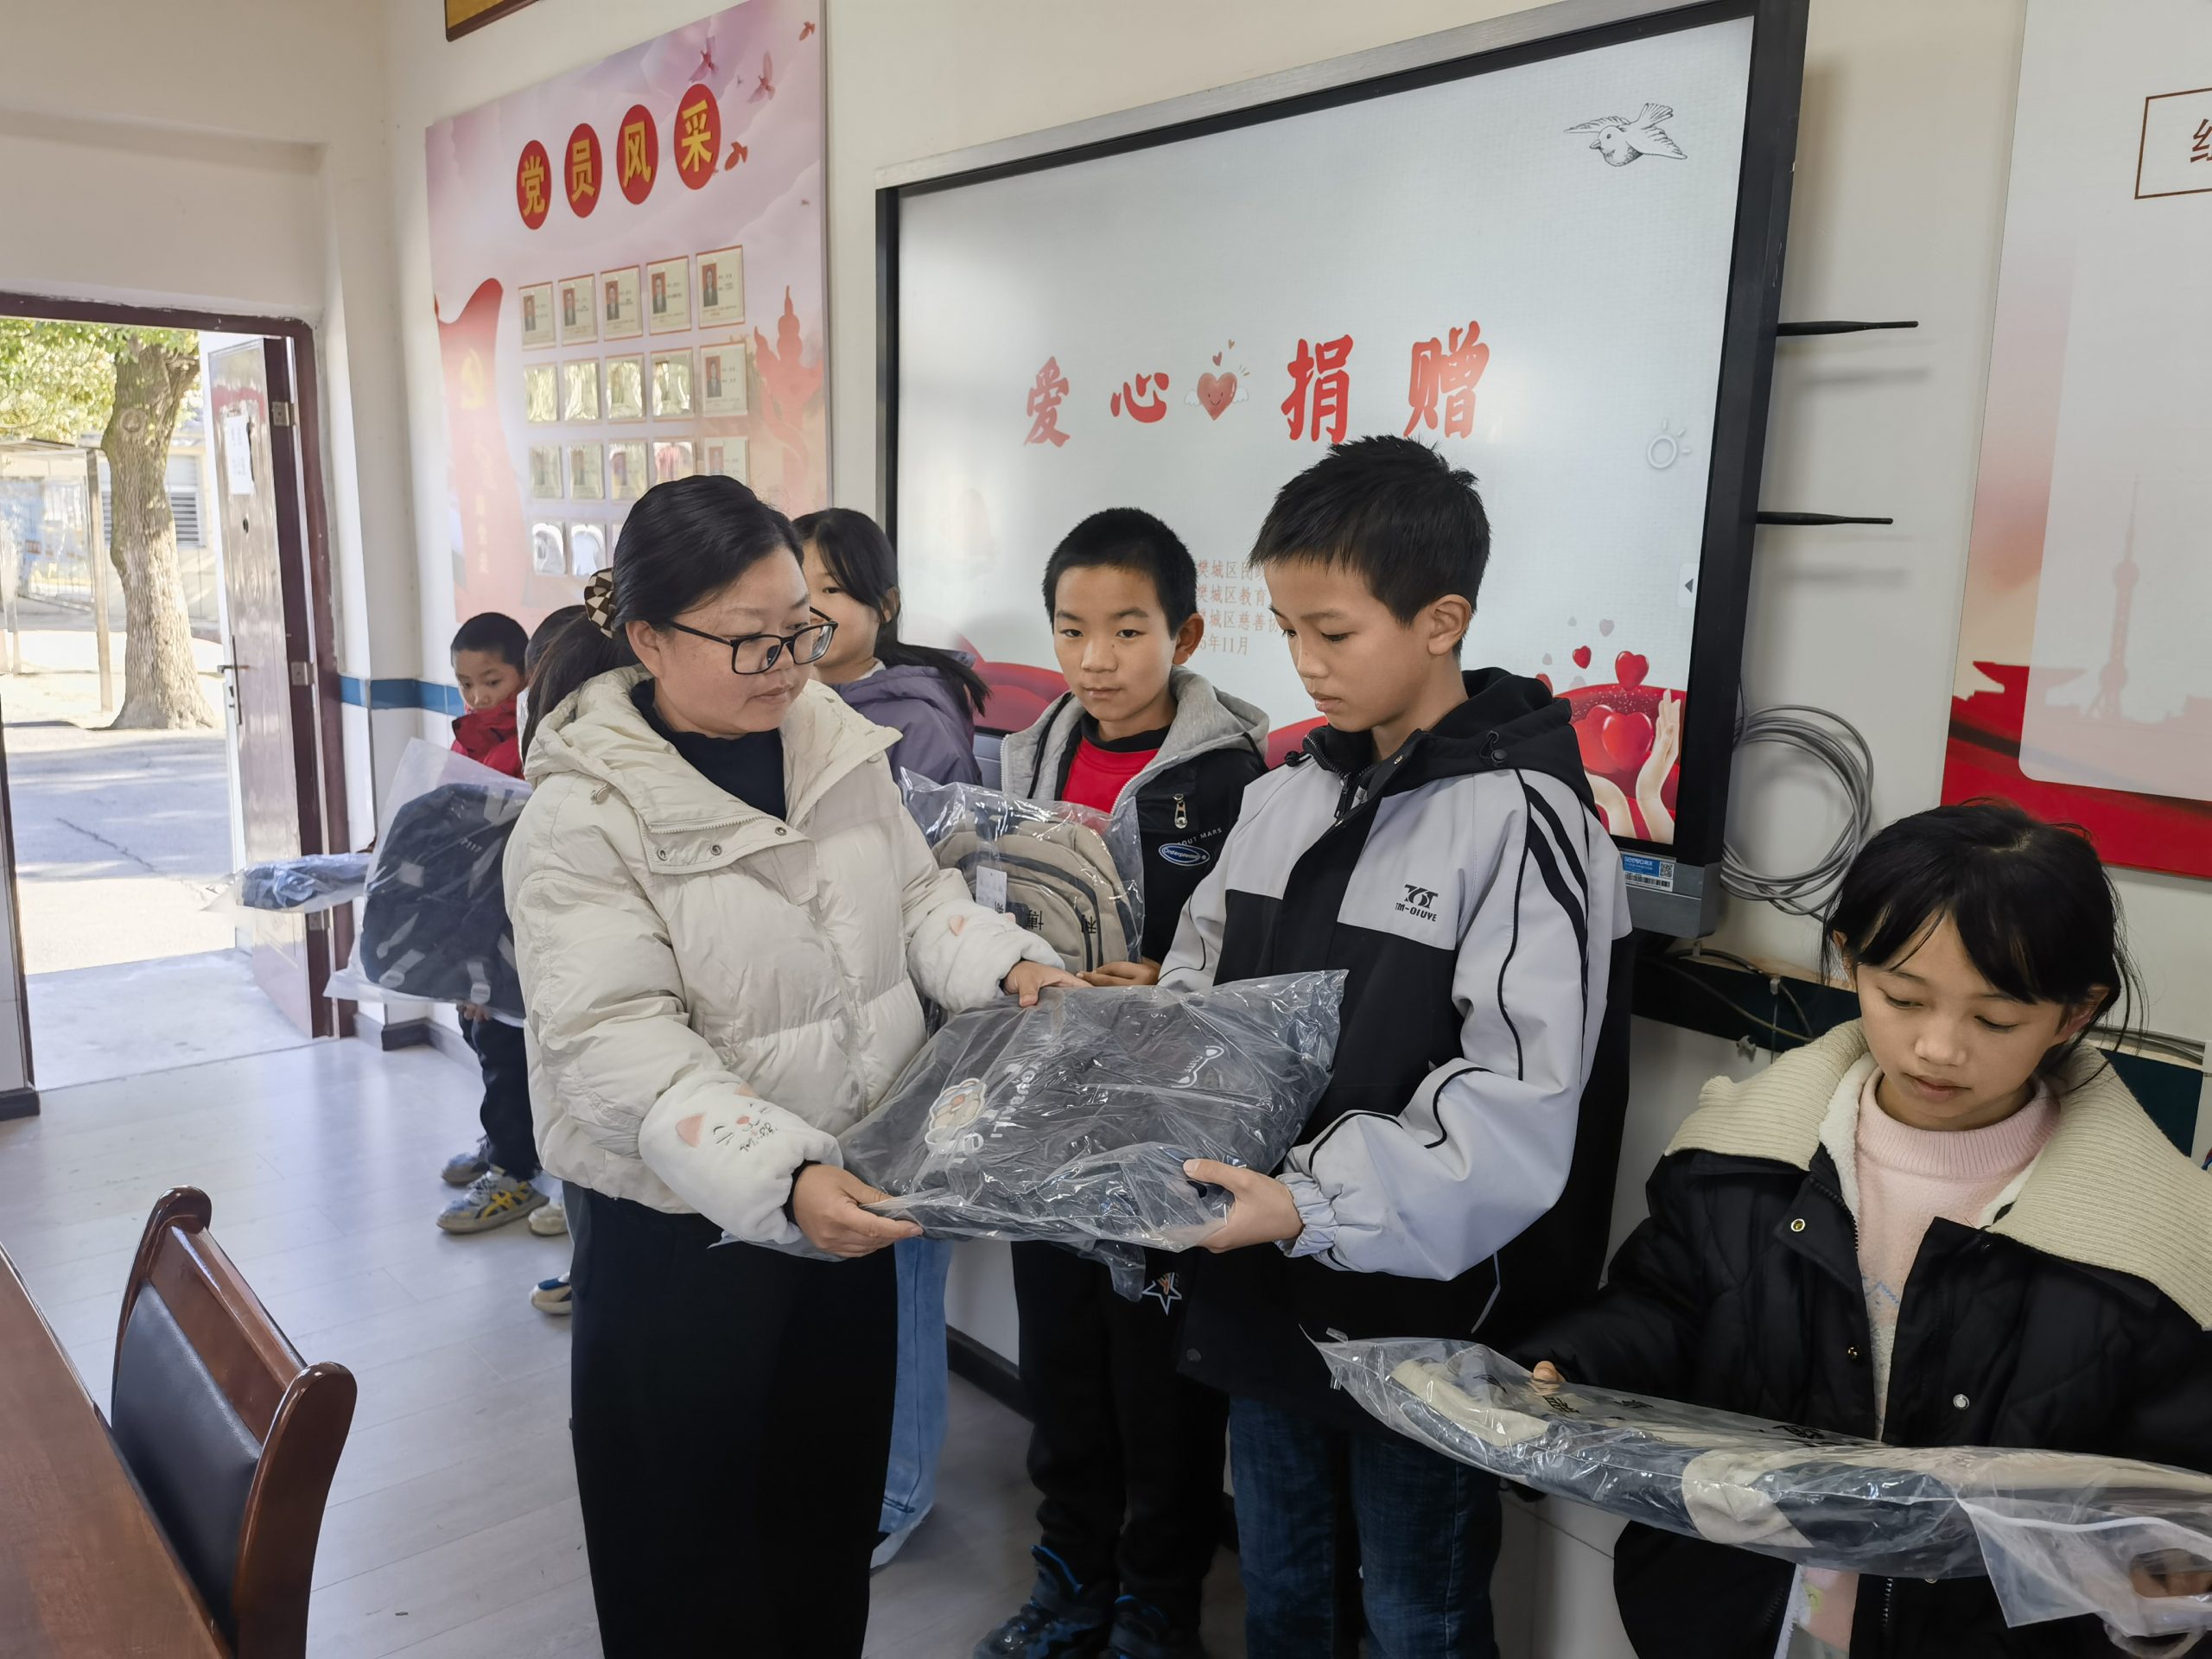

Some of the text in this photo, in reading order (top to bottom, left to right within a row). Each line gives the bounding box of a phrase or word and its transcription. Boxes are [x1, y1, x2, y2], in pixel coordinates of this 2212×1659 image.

[521, 99, 713, 217] 党员风采
[1200, 827, 1223, 839] MARS
